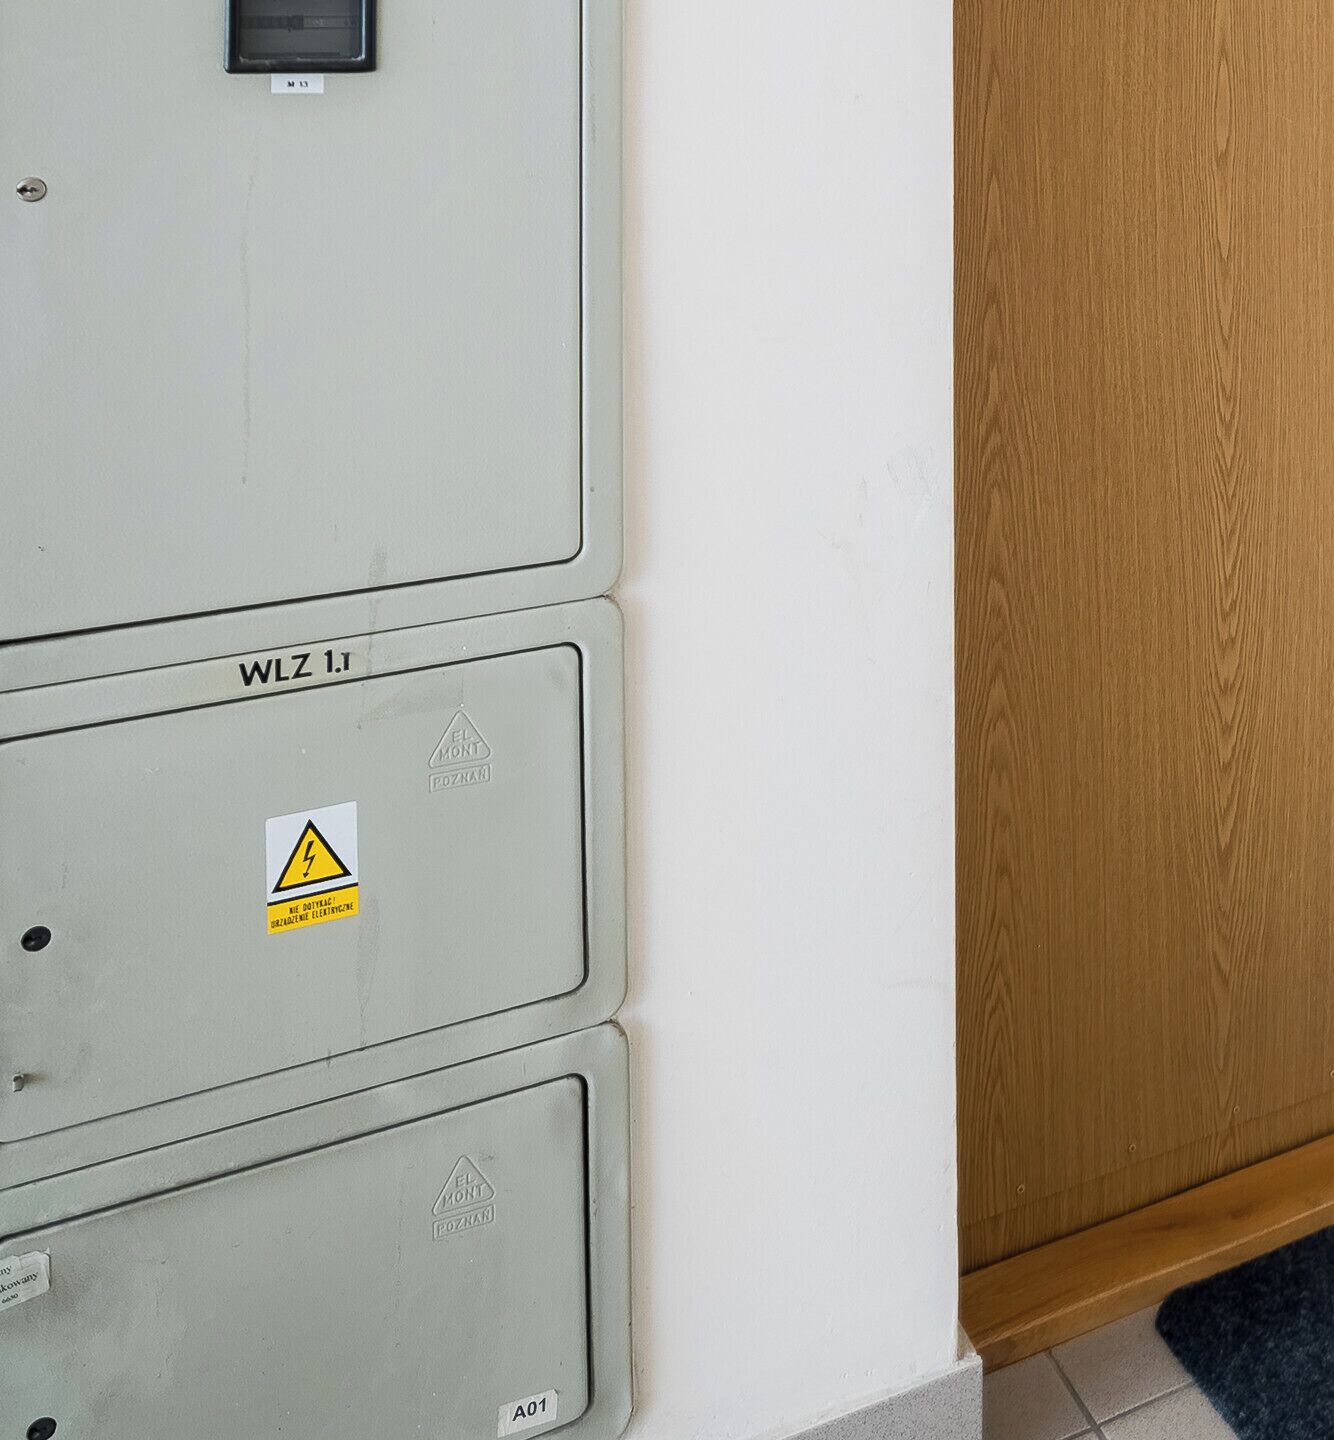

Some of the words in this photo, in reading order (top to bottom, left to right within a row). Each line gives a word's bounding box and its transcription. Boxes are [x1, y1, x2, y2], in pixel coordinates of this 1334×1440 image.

[238, 652, 313, 687] WLZ
[452, 729, 474, 743] EL
[439, 741, 481, 761] MONT
[289, 904, 299, 914] NIE
[312, 902, 354, 919] ELEKTRYCZNE
[455, 1173, 477, 1187] EL
[442, 1183, 487, 1208] MONT
[512, 1397, 547, 1422] A01
